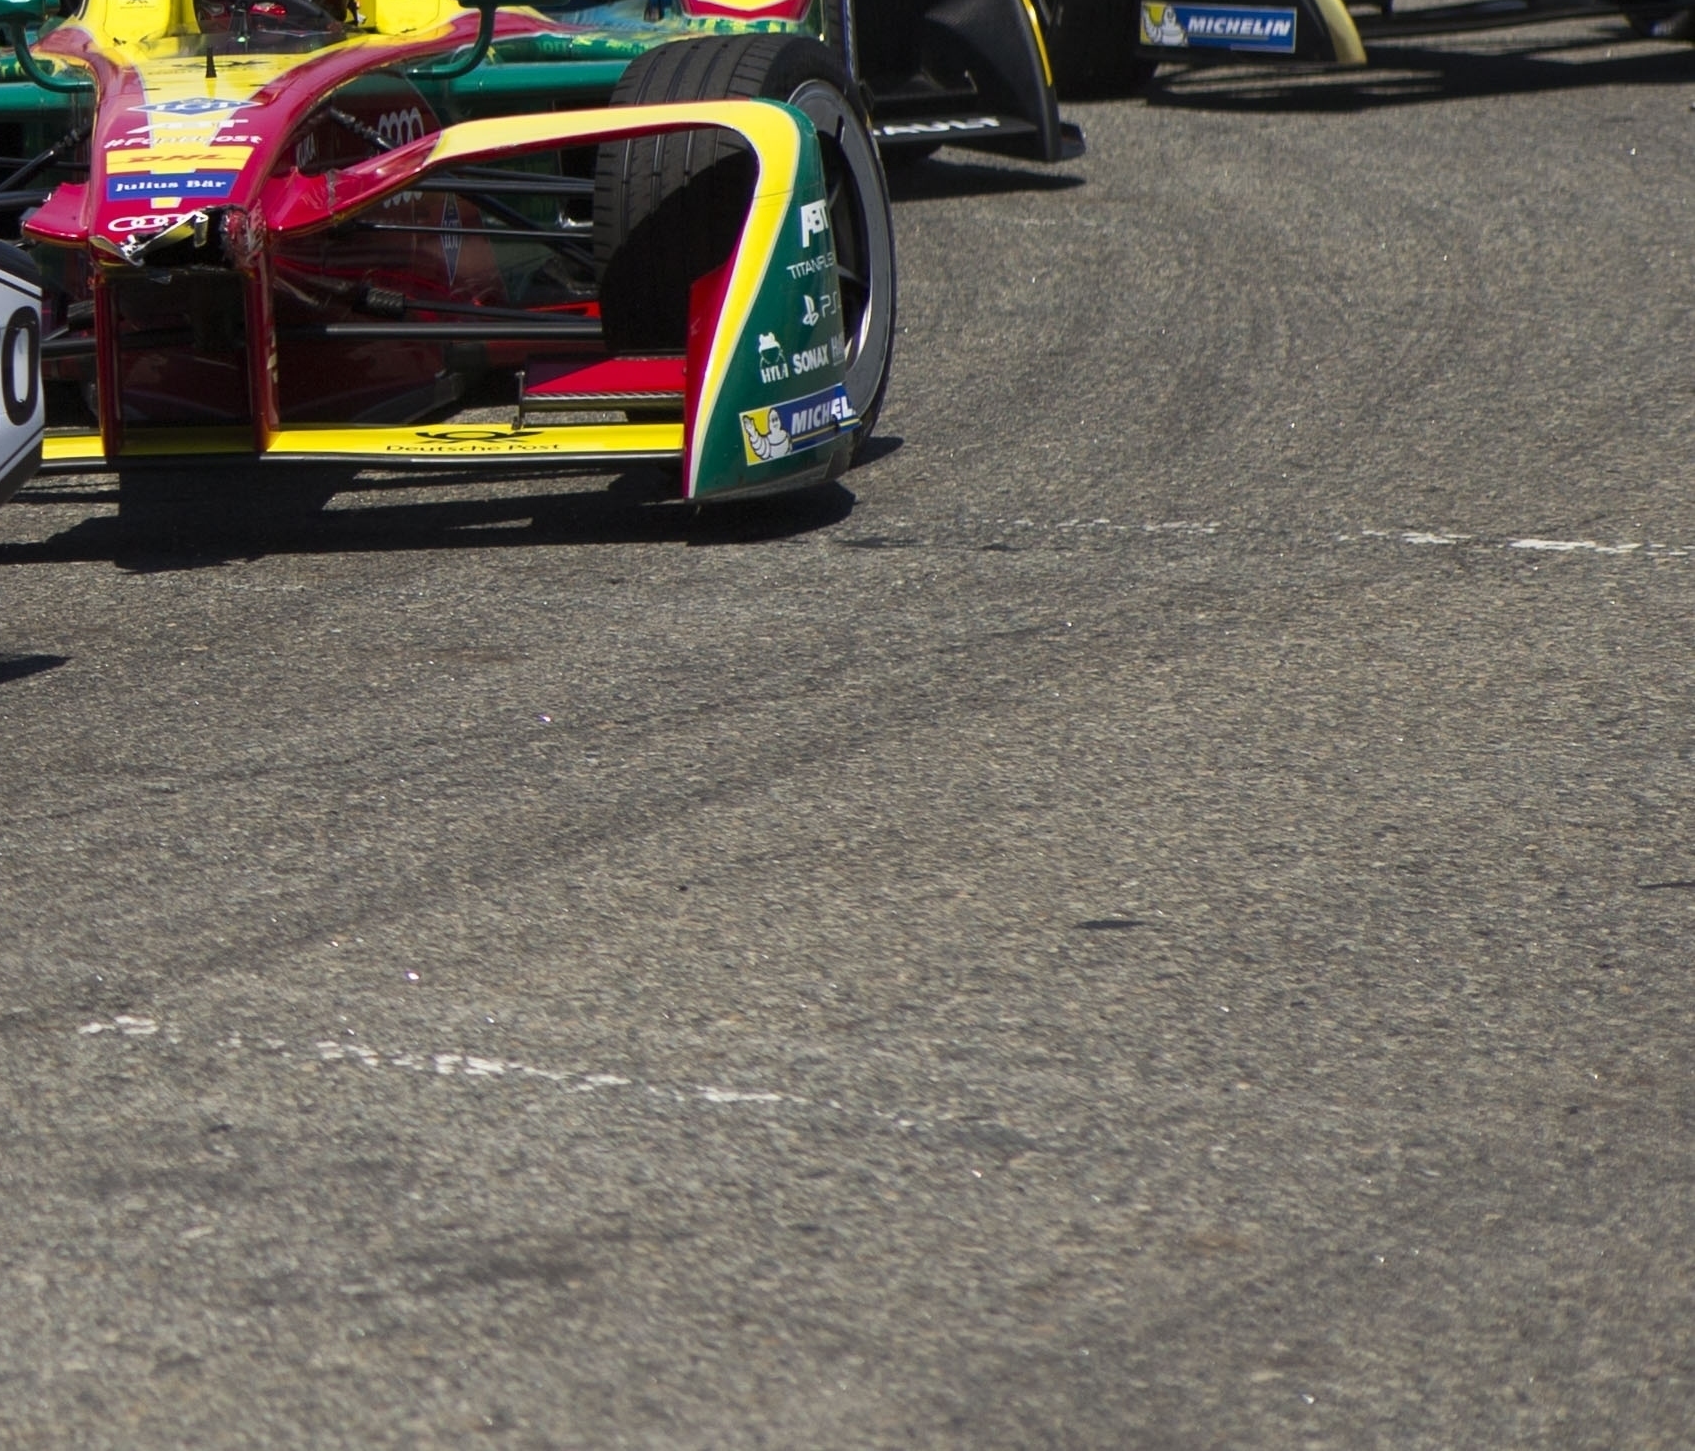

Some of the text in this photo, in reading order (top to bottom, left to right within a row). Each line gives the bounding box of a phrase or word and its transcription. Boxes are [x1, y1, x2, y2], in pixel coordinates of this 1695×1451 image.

[1187, 15, 1292, 37] MICHELIN
[115, 178, 228, 192] Julius Bär
[792, 343, 830, 376] SONAX
[385, 442, 561, 452] Deutsche Post
